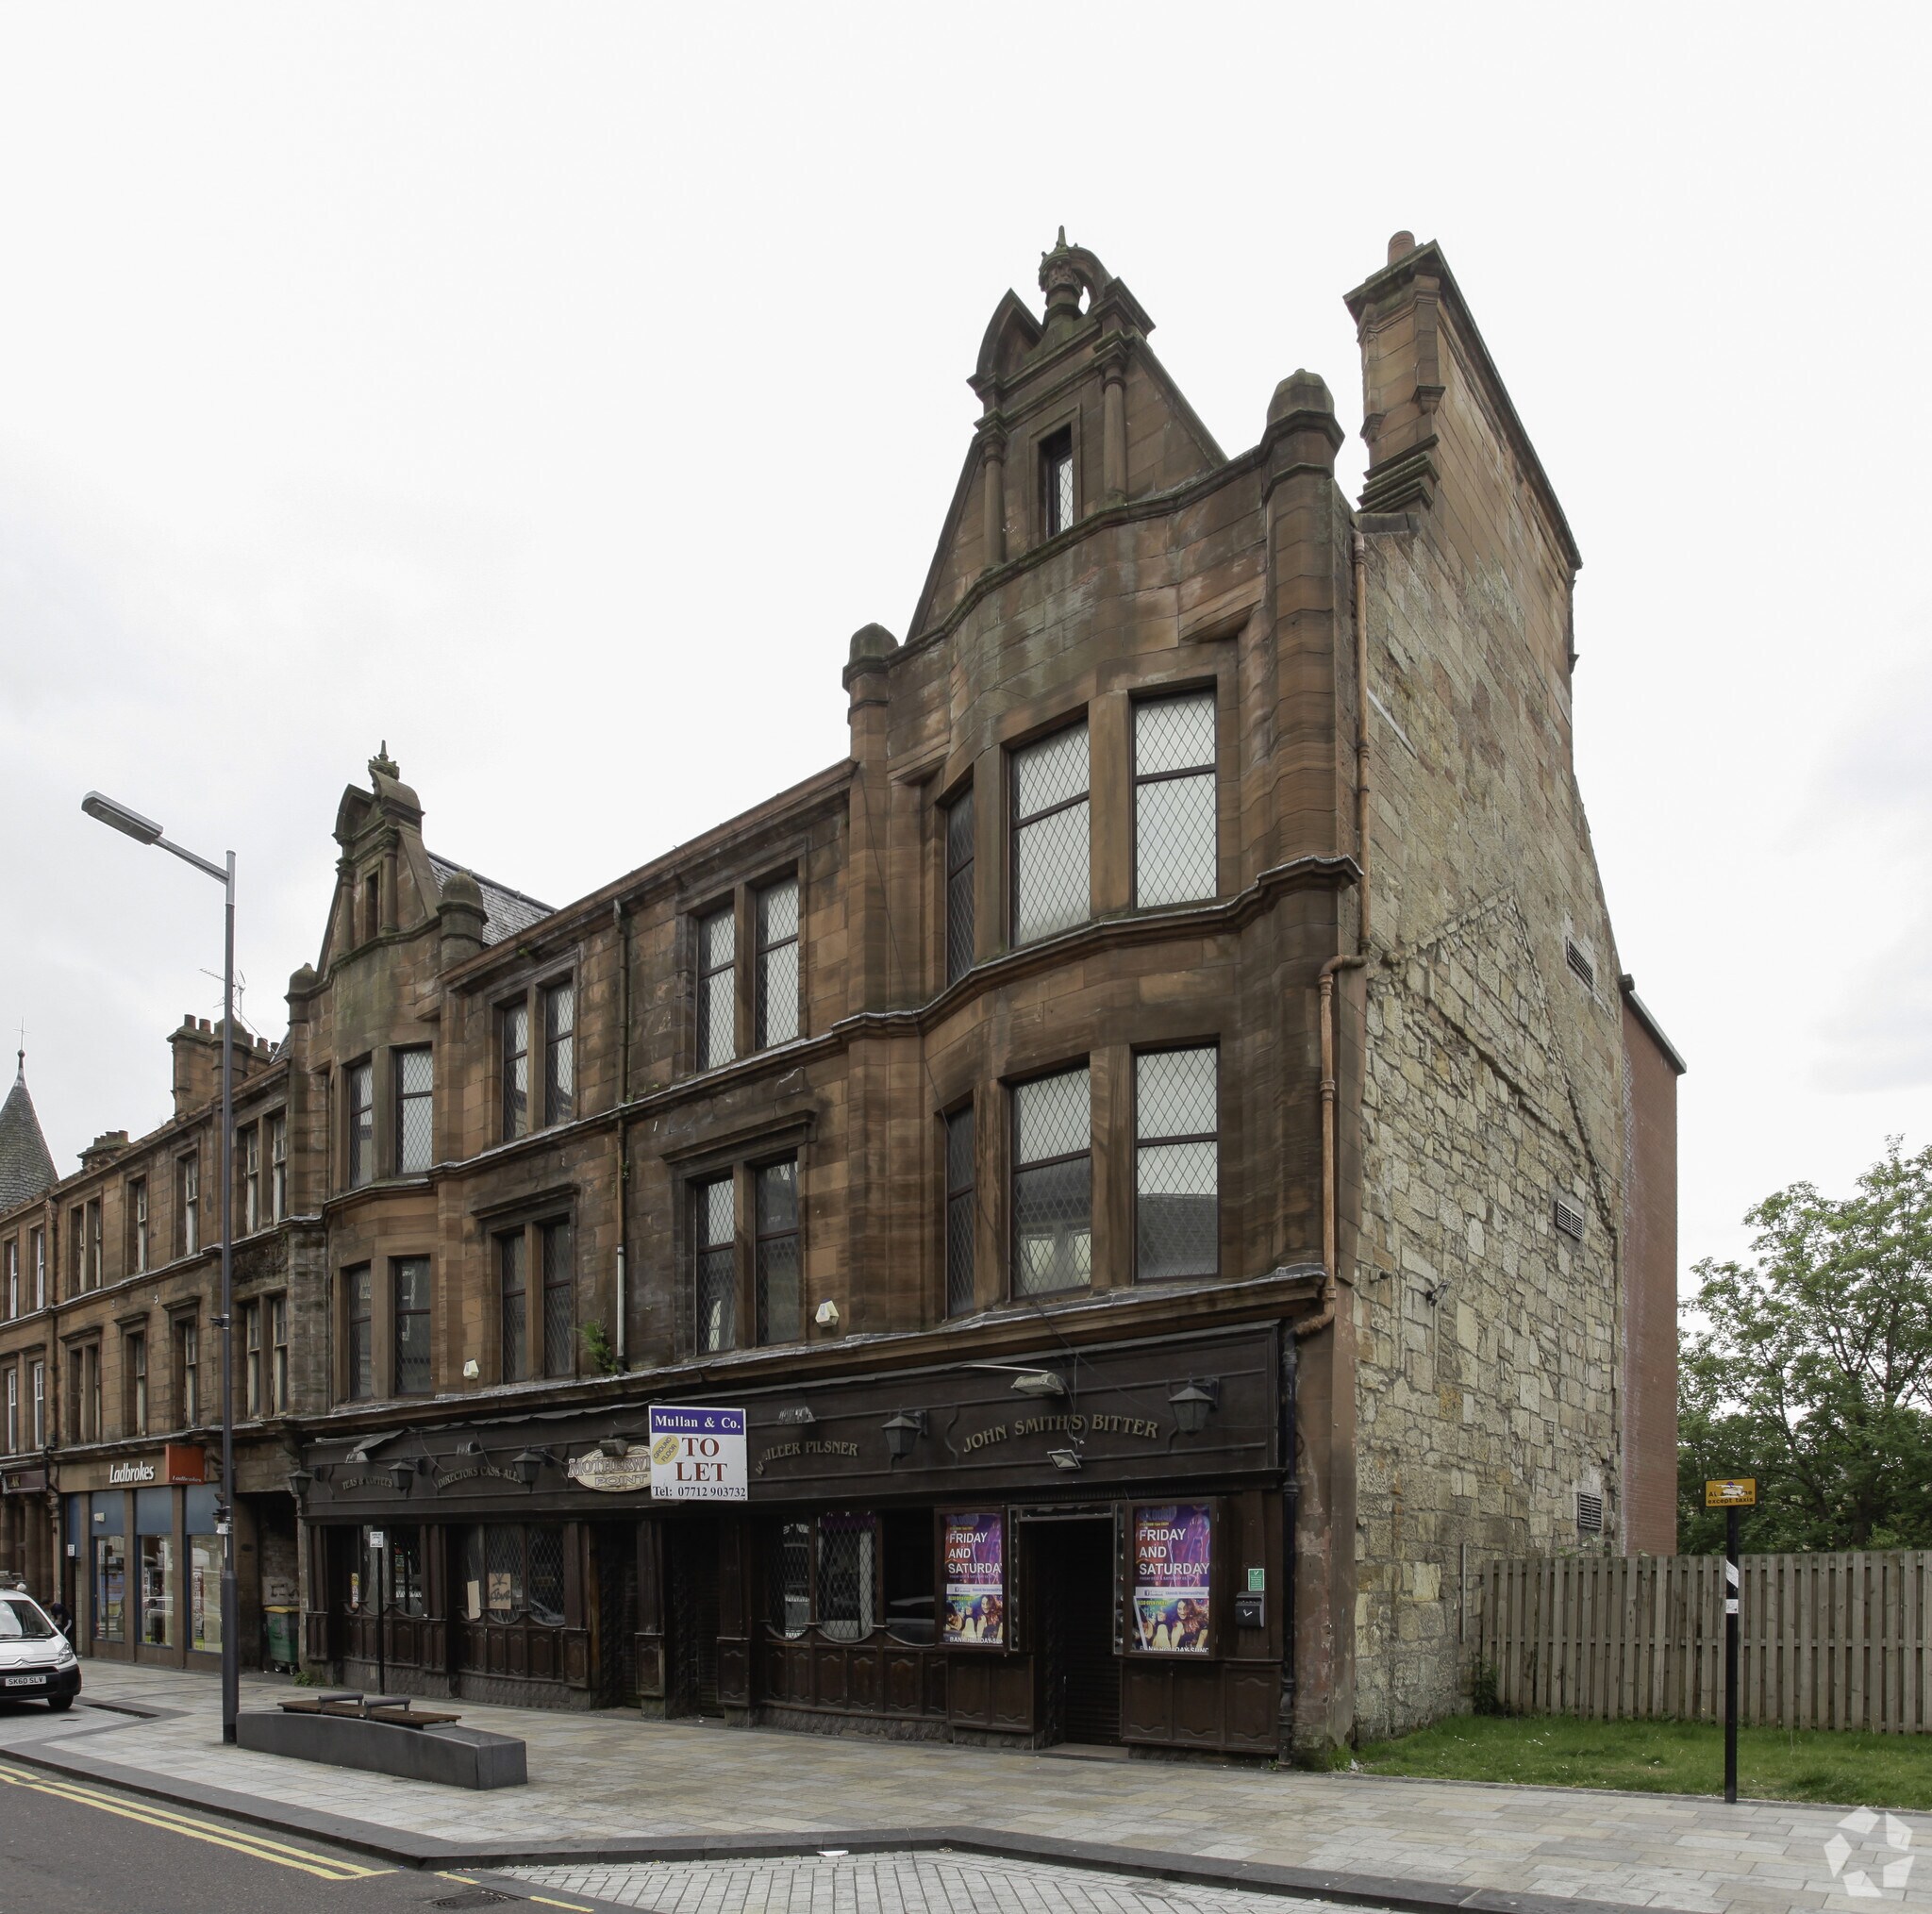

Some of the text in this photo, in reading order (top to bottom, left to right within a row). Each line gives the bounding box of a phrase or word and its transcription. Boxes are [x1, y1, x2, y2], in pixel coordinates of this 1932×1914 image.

[655, 1415, 741, 1429] Mullan & Co.
[963, 1424, 1008, 1453] JOHN
[1091, 1414, 1158, 1439] BITTER
[653, 1437, 672, 1459] GROUND
[661, 1443, 677, 1462] FLOOR
[681, 1437, 720, 1457] TO
[805, 1440, 858, 1457] PILSNER
[109, 1460, 156, 1485] Ladbrokes
[438, 1466, 479, 1490] DIRECTORS
[675, 1461, 728, 1482] LET
[341, 1478, 358, 1490] TEAS
[594, 1474, 648, 1487] POINT
[653, 1486, 746, 1498] Tel: 07712 903732
[949, 1532, 988, 1544] FRIDAY
[1140, 1528, 1186, 1541] FRIDAY
[948, 1548, 971, 1559] AND
[1139, 1546, 1167, 1558] AND
[1139, 1562, 1210, 1575] SATURDAY
[8, 1677, 28, 1686] SK60
